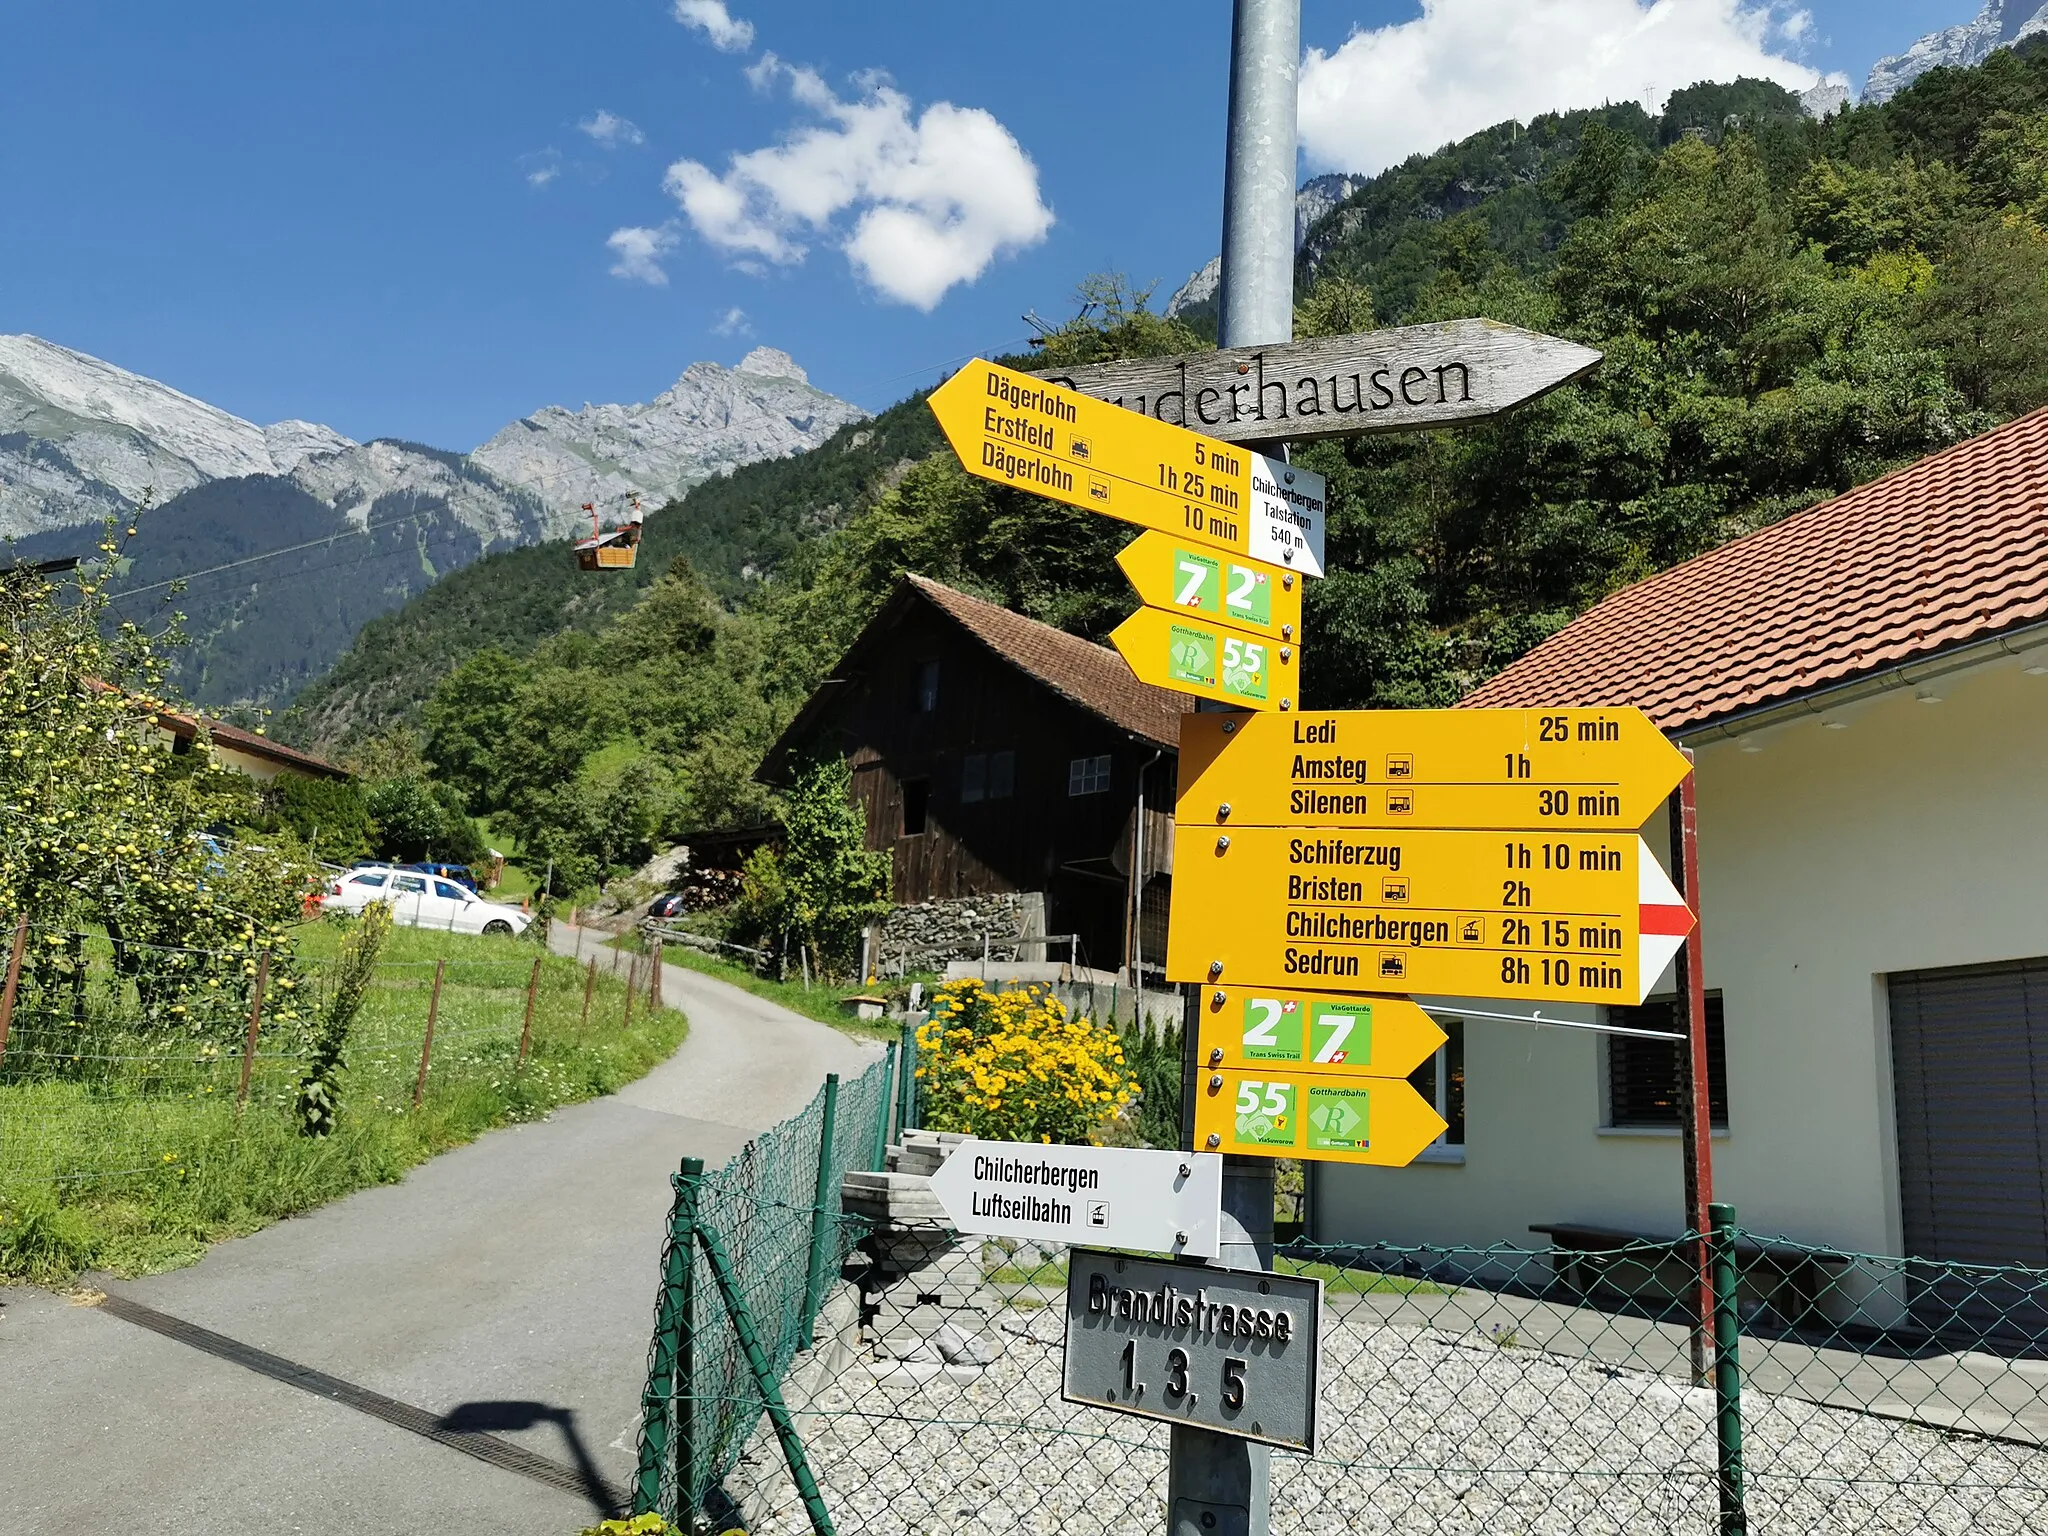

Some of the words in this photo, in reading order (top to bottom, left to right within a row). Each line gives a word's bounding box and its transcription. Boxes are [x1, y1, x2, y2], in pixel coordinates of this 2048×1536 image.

[1043, 352, 1476, 430] derhausen
[987, 372, 1077, 424] Dägerlohn
[1195, 442, 1205, 465] 5
[1211, 452, 1240, 477] min
[984, 406, 1054, 451] Erstfeld
[1158, 463, 1177, 490] 1h
[1183, 472, 1204, 498] 25
[1210, 484, 1238, 509] min
[982, 441, 1073, 492] Dägerlohn
[1184, 504, 1204, 531] 10
[1209, 516, 1238, 542] min
[1252, 476, 1323, 513] Chilcherbergen
[1263, 501, 1312, 530] Talstation
[1271, 526, 1291, 545] 540
[1294, 536, 1303, 549] m
[1174, 560, 1208, 606] 7
[1226, 564, 1256, 610] 2
[1171, 625, 1214, 642] Gotthardbahn
[1223, 637, 1264, 672] 55
[1293, 719, 1336, 744] Ledi
[1539, 716, 1568, 741] 25
[1578, 716, 1619, 741] min
[1291, 754, 1367, 784] Amsteg
[1504, 753, 1530, 778] 1h
[1290, 789, 1367, 814] Silenen
[1539, 790, 1569, 816] 30
[1578, 790, 1619, 816] min
[1289, 838, 1401, 871] Schiferzug
[1505, 843, 1531, 869] 1h
[1542, 843, 1570, 870] 10
[1580, 845, 1621, 871] min
[1288, 875, 1362, 902] Bristen
[1502, 880, 1531, 907] 2h
[1286, 911, 1449, 947] Chilcherbergen
[1502, 919, 1530, 945] 2h
[1542, 920, 1569, 947] 15
[1580, 922, 1621, 949] min
[1284, 948, 1358, 977] Sedrun
[1501, 956, 1530, 984] 8h
[1541, 958, 1570, 986] 10
[1580, 962, 1622, 989] min
[1331, 1004, 1370, 1012] ViaGottardo
[1242, 998, 1282, 1046] 2
[1312, 1014, 1356, 1063] 7
[1268, 1051, 1285, 1059] Swiss
[1286, 1052, 1300, 1060] Trail
[1235, 1080, 1291, 1116] 55
[1310, 1088, 1366, 1098] Gotthardbahn
[1322, 1107, 1344, 1134] R
[974, 1156, 1098, 1194] Chilcherbergen
[972, 1191, 1071, 1225] Luftseilbahn
[1088, 1272, 1293, 1344] Brandistrasse
[1122, 1339, 1146, 1397] 1,
[1166, 1347, 1199, 1406] 3,
[1222, 1356, 1248, 1410] 5
